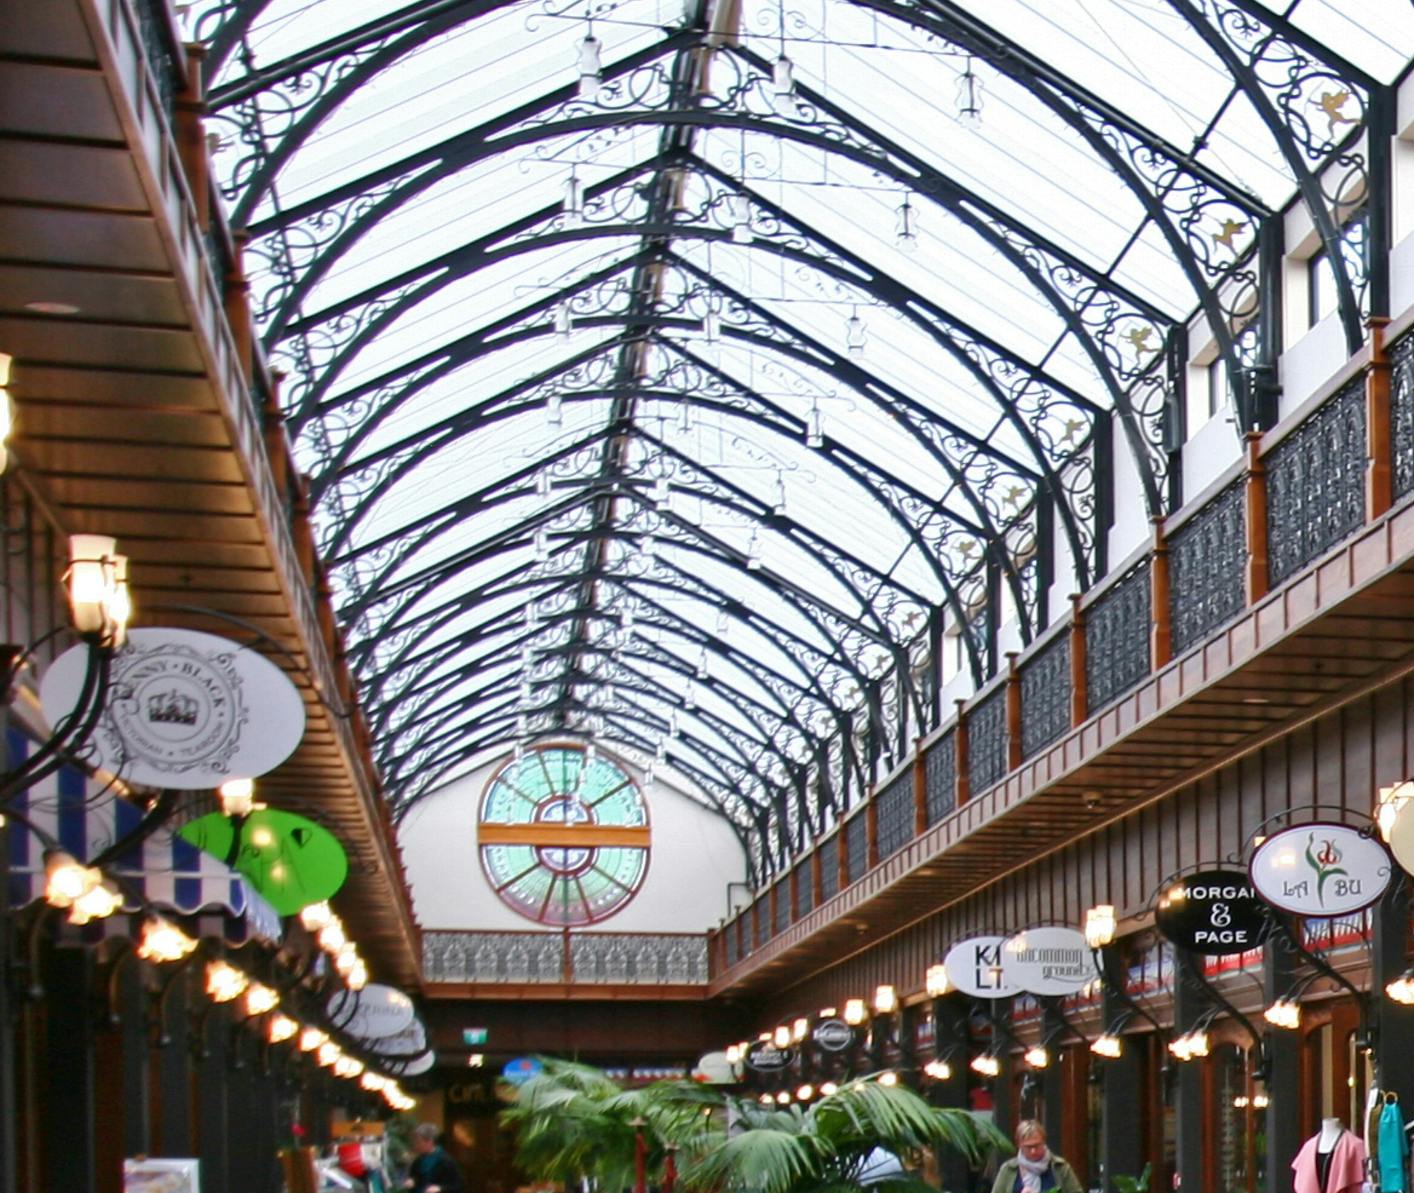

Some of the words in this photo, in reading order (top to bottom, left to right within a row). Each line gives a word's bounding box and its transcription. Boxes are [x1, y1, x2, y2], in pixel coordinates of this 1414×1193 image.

[181, 662, 226, 708] BLACK
[1283, 880, 1309, 898] LA
[1334, 879, 1362, 897] BU
[1210, 902, 1232, 928] &
[1194, 930, 1249, 944] PAGE
